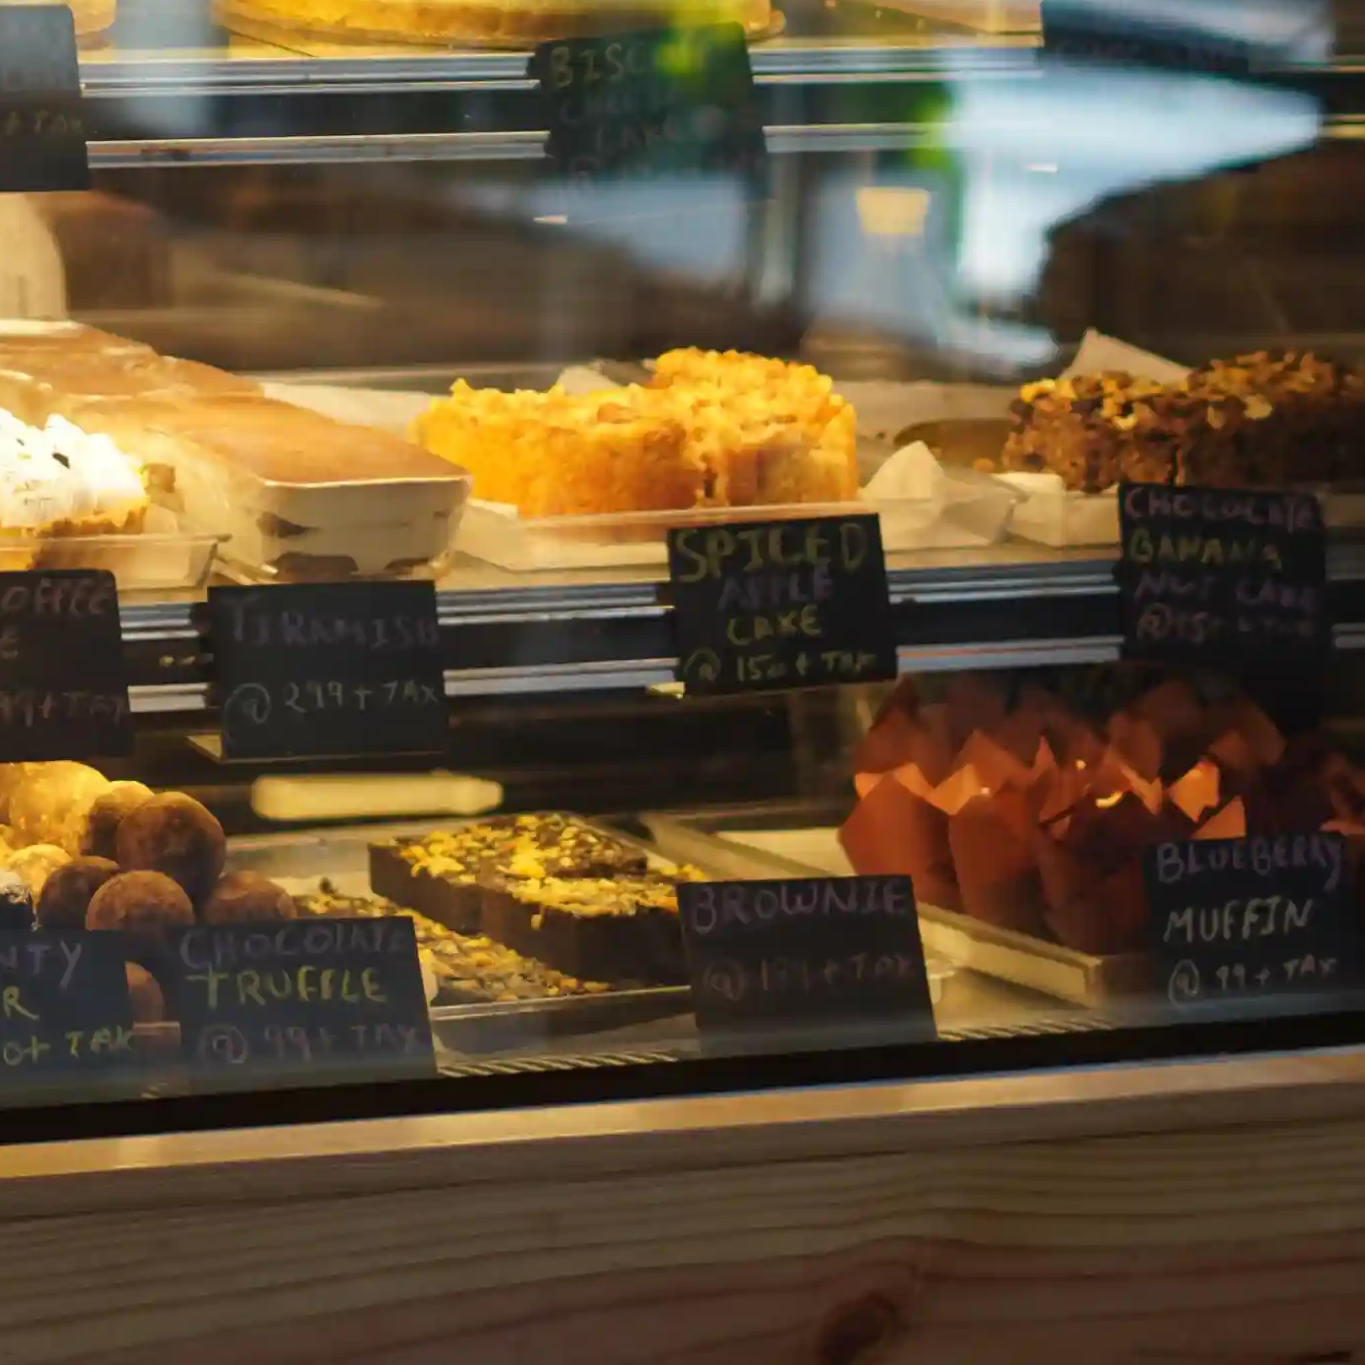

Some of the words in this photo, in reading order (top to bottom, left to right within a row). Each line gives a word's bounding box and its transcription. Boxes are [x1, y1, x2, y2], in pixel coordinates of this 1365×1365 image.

[675, 521, 868, 584] SPICED
[726, 603, 823, 647] CAKE
[1156, 833, 1343, 894] BLUEBERRY
[691, 880, 906, 935] BROWNIE
[1162, 893, 1314, 943] MUFFIN
[185, 963, 388, 1009] TRUFFLE
